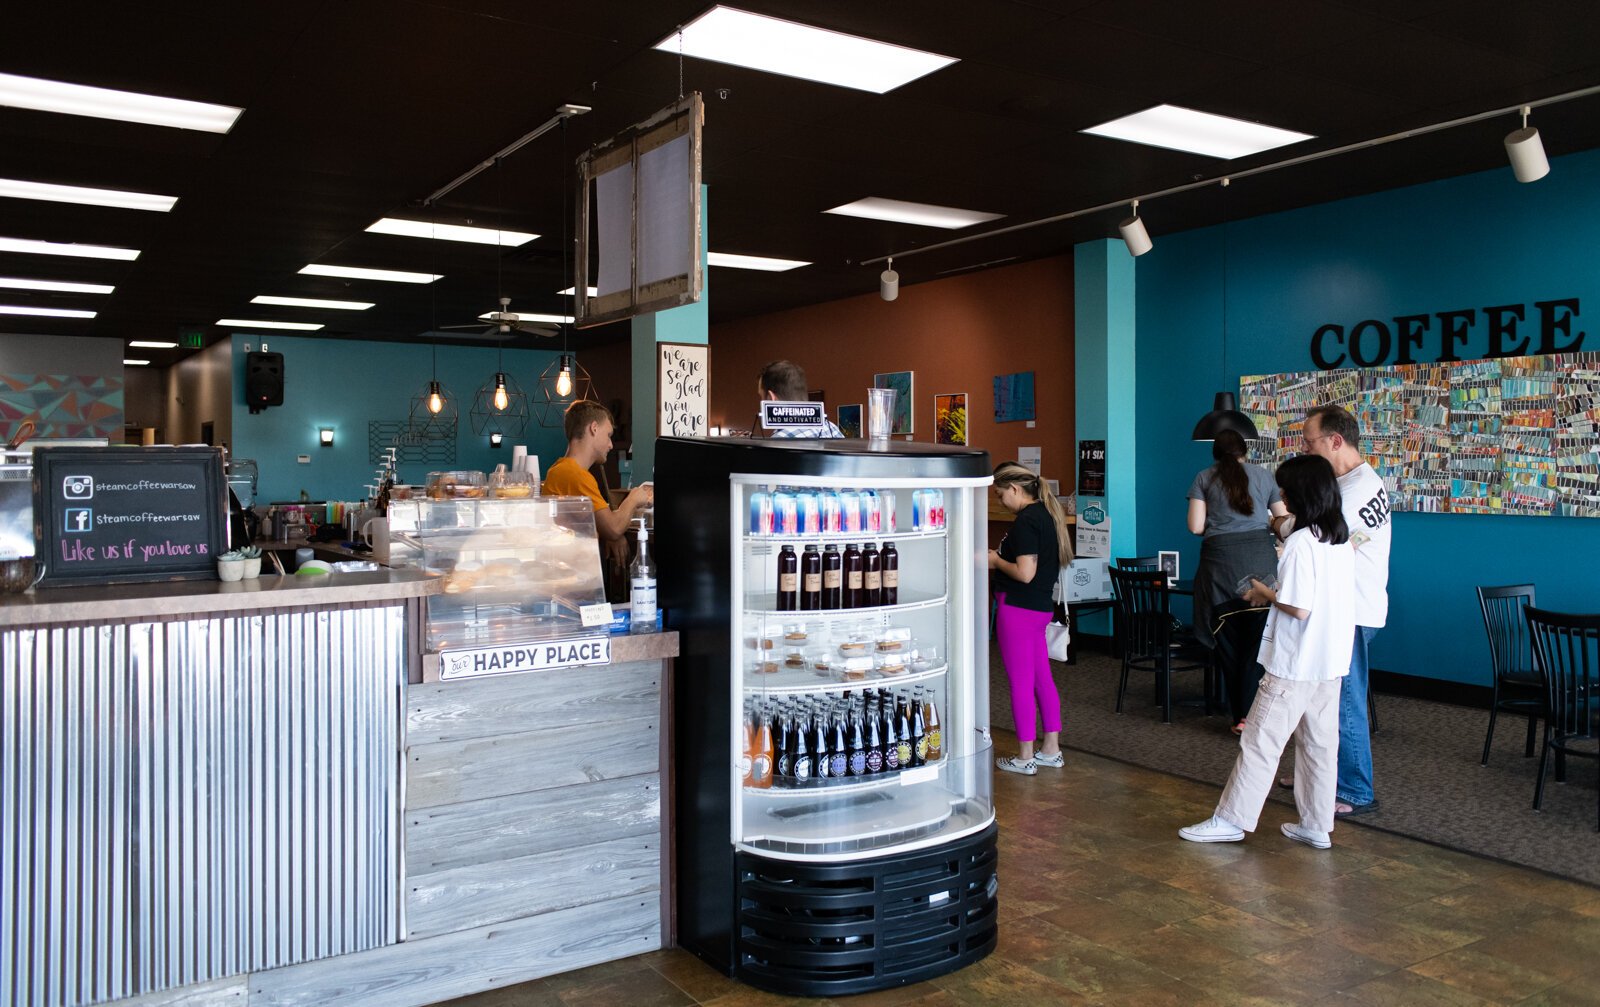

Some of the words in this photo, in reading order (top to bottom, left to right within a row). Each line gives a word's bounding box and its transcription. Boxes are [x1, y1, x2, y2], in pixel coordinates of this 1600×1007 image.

[1310, 297, 1586, 371] COFFEE
[664, 349, 683, 365] we
[679, 358, 701, 376] are
[667, 369, 683, 385] so
[676, 374, 704, 400] glad
[664, 400, 689, 425] you
[772, 407, 815, 416] CAFFEINATED
[680, 412, 705, 431] are
[95, 479, 197, 491] steamcoffeewarsaw
[61, 538, 95, 561] Like
[101, 545, 120, 559] us
[123, 539, 136, 559] if
[140, 544, 165, 562] you
[166, 540, 192, 556] love
[195, 543, 208, 555] us
[450, 655, 471, 674] our
[474, 648, 538, 671] HAPPY
[546, 643, 601, 664] PLACE
